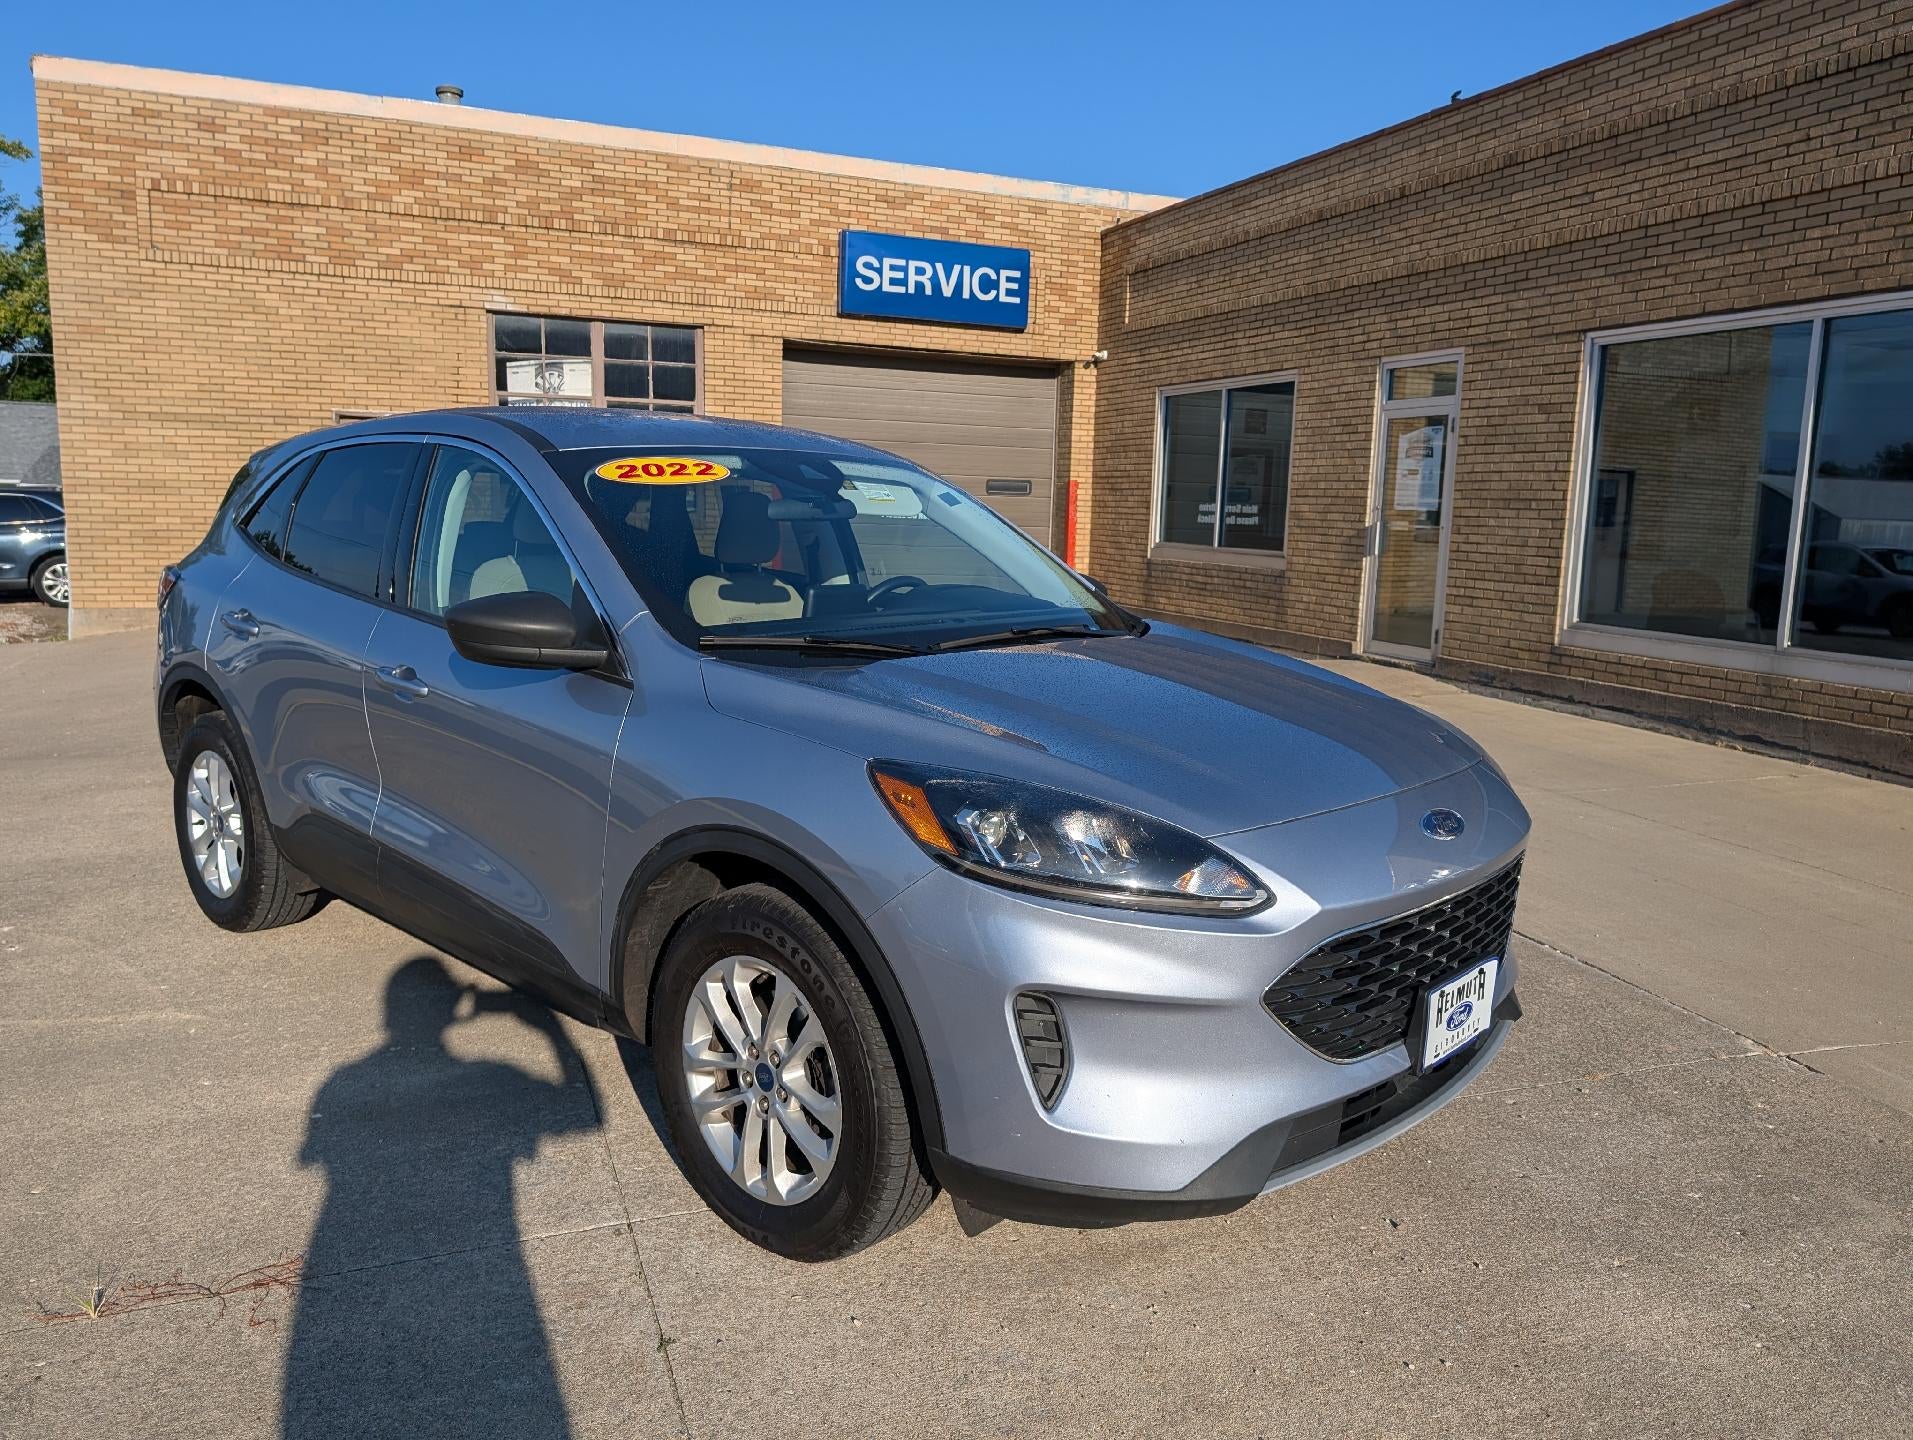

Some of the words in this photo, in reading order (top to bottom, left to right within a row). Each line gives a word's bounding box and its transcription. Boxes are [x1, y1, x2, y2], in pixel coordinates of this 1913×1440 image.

[854, 255, 1021, 304] SERVICE
[614, 462, 718, 479] 2022
[1435, 969, 1486, 1028] HELMUTH
